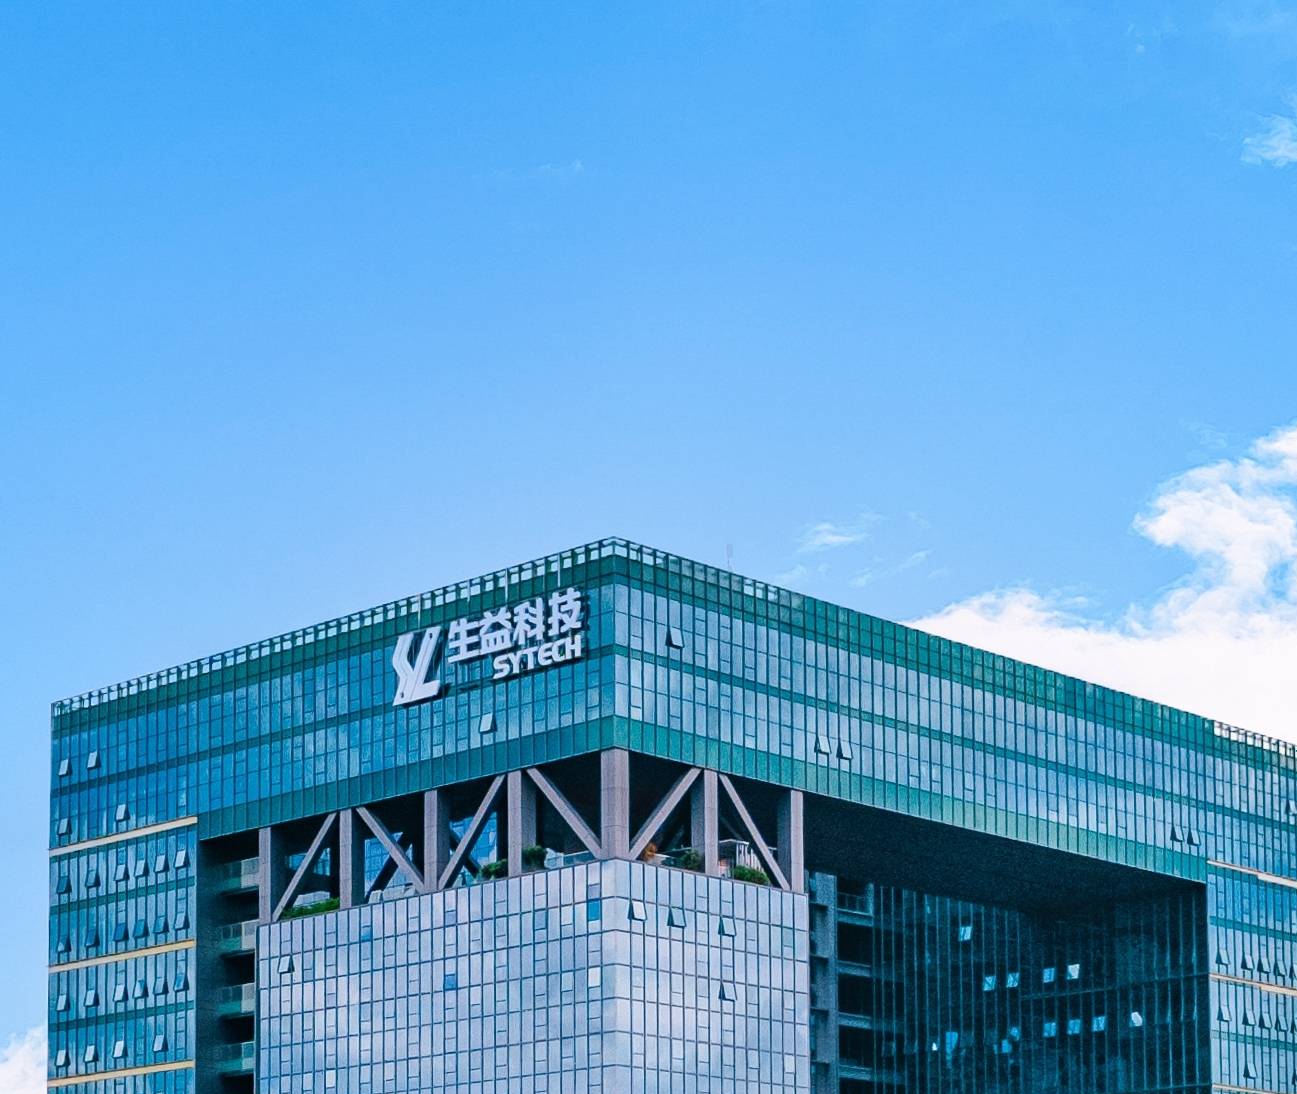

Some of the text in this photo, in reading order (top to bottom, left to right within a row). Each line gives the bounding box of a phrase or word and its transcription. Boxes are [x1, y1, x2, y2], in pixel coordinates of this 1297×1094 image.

[447, 587, 583, 664] 生益科技
[492, 633, 583, 680] SYTECH
